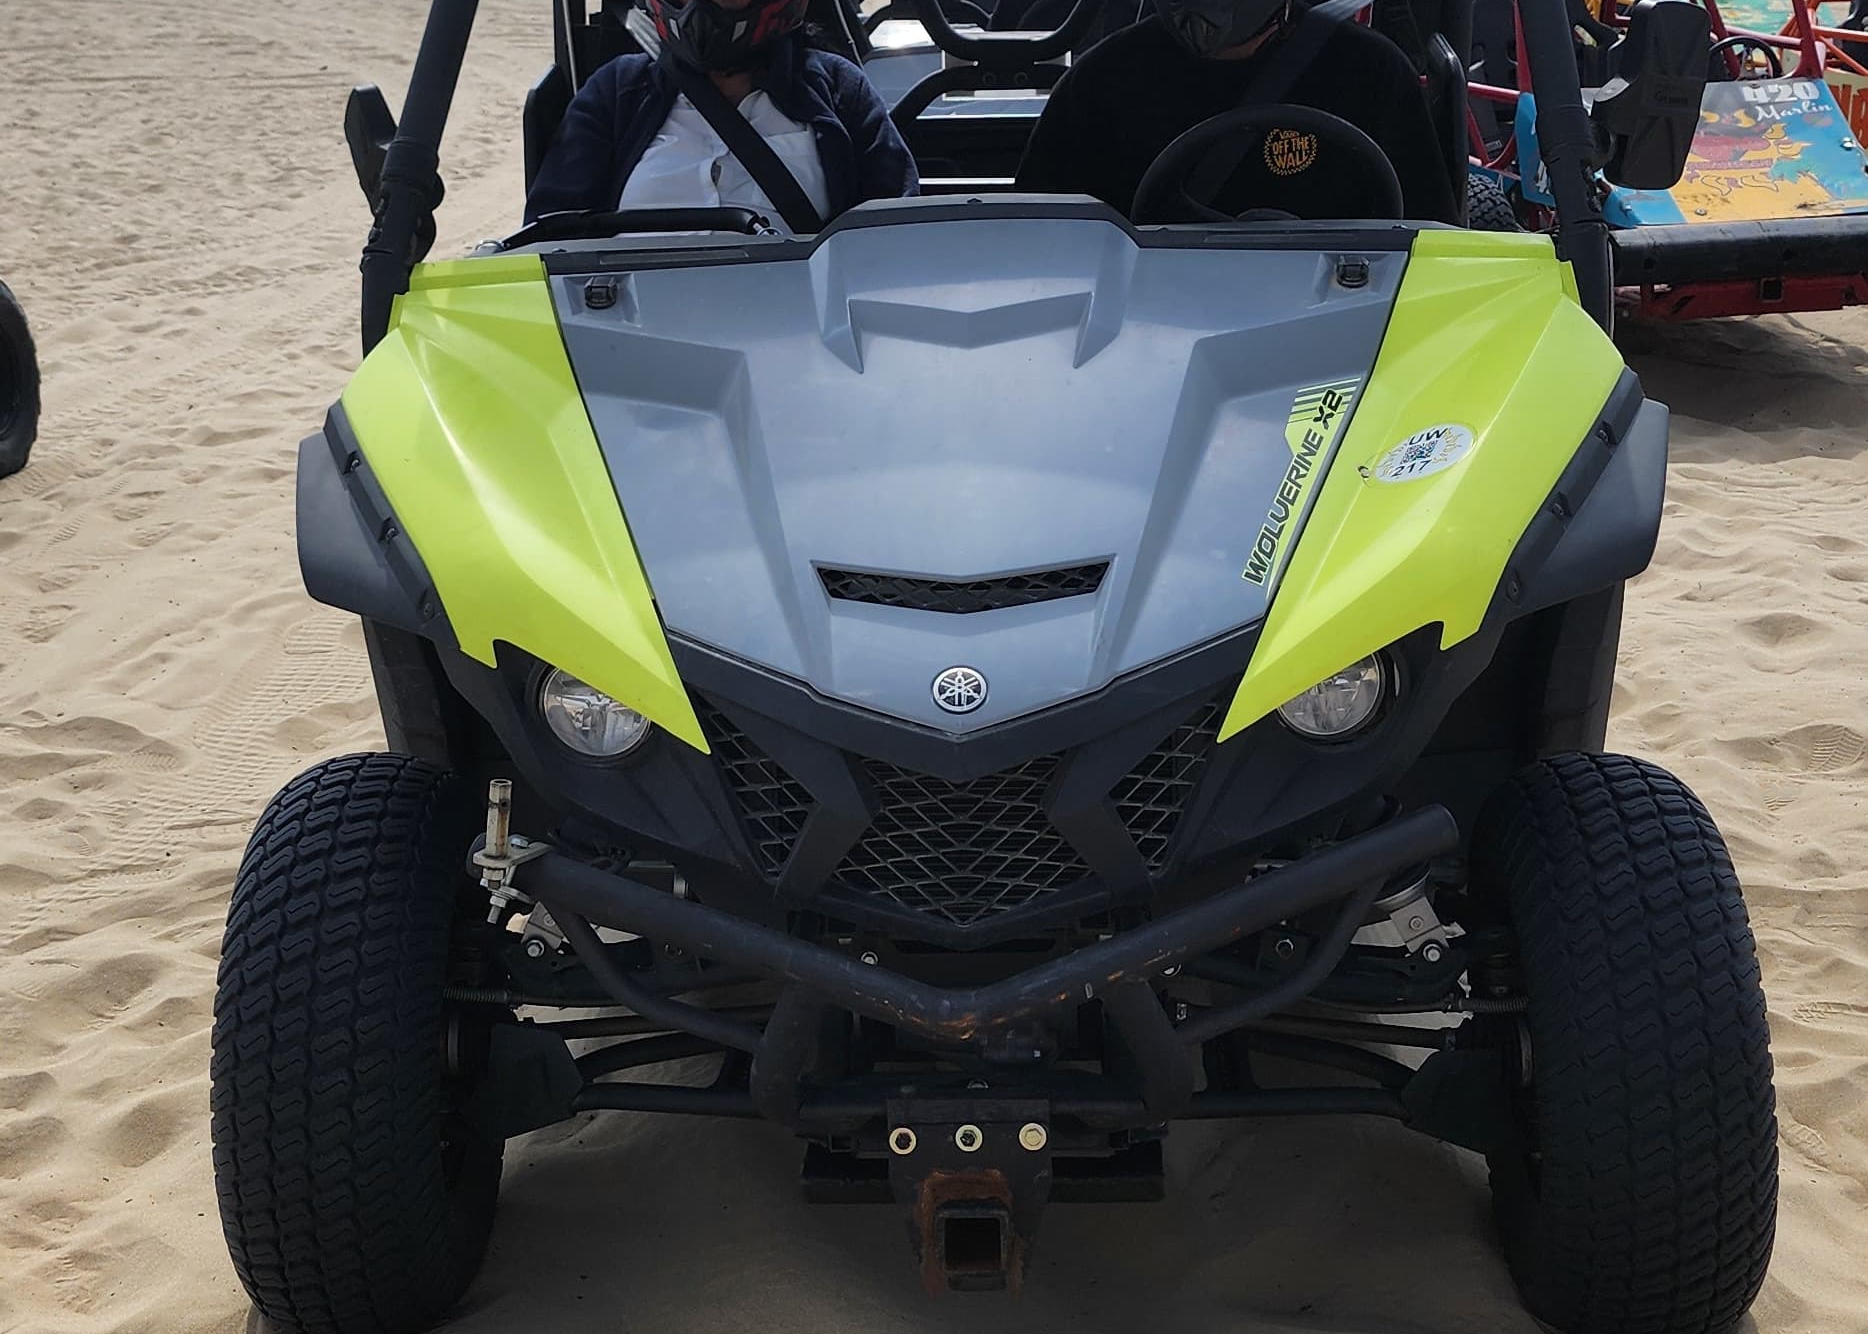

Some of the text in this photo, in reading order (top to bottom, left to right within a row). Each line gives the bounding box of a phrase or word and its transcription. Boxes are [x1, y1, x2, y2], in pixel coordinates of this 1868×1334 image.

[1741, 81, 1820, 104] 420
[1754, 100, 1833, 122] Marlin
[1272, 136, 1309, 155] OFF THE
[1273, 151, 1309, 169] WALL
[1408, 427, 1449, 446] UW
[1391, 459, 1432, 478] 217
[1243, 389, 1343, 585] WOLVERINE X2
